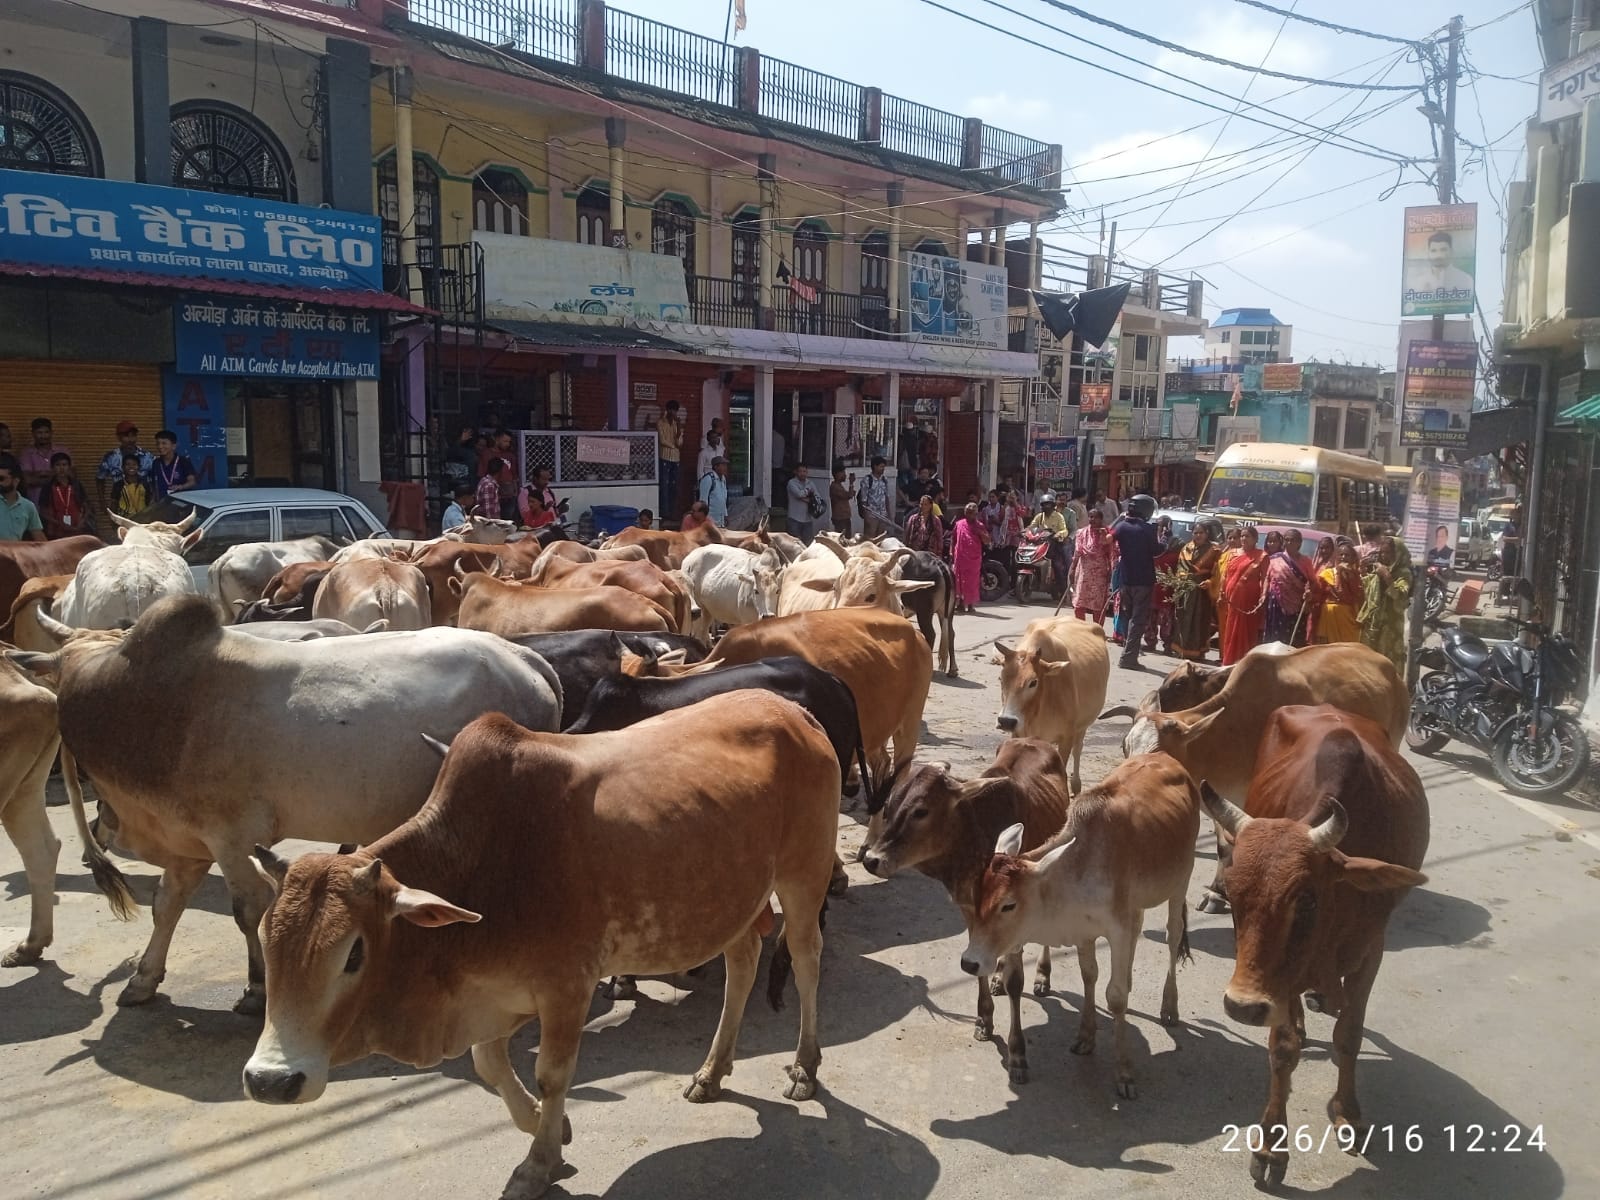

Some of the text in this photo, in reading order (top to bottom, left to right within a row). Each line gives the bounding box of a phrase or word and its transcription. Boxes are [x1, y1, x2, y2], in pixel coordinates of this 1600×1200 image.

[0, 193, 122, 242] टिव
[130, 203, 247, 253] बैंक
[89, 247, 132, 263] प्रधान
[136, 250, 202, 268] कार्यालय
[205, 256, 245, 272] लाला
[298, 264, 349, 282] अल्मोड़ा
[1403, 287, 1433, 301] दीपक
[183, 300, 228, 327] अल्मोड़ा
[231, 303, 260, 327] अर्बन
[201, 354, 217, 372] All
[248, 357, 279, 374] Cards
[281, 359, 297, 375] Are
[297, 360, 330, 378] Accepted
[341, 362, 357, 377] This
[1225, 469, 1297, 481] UNIVERSAL
